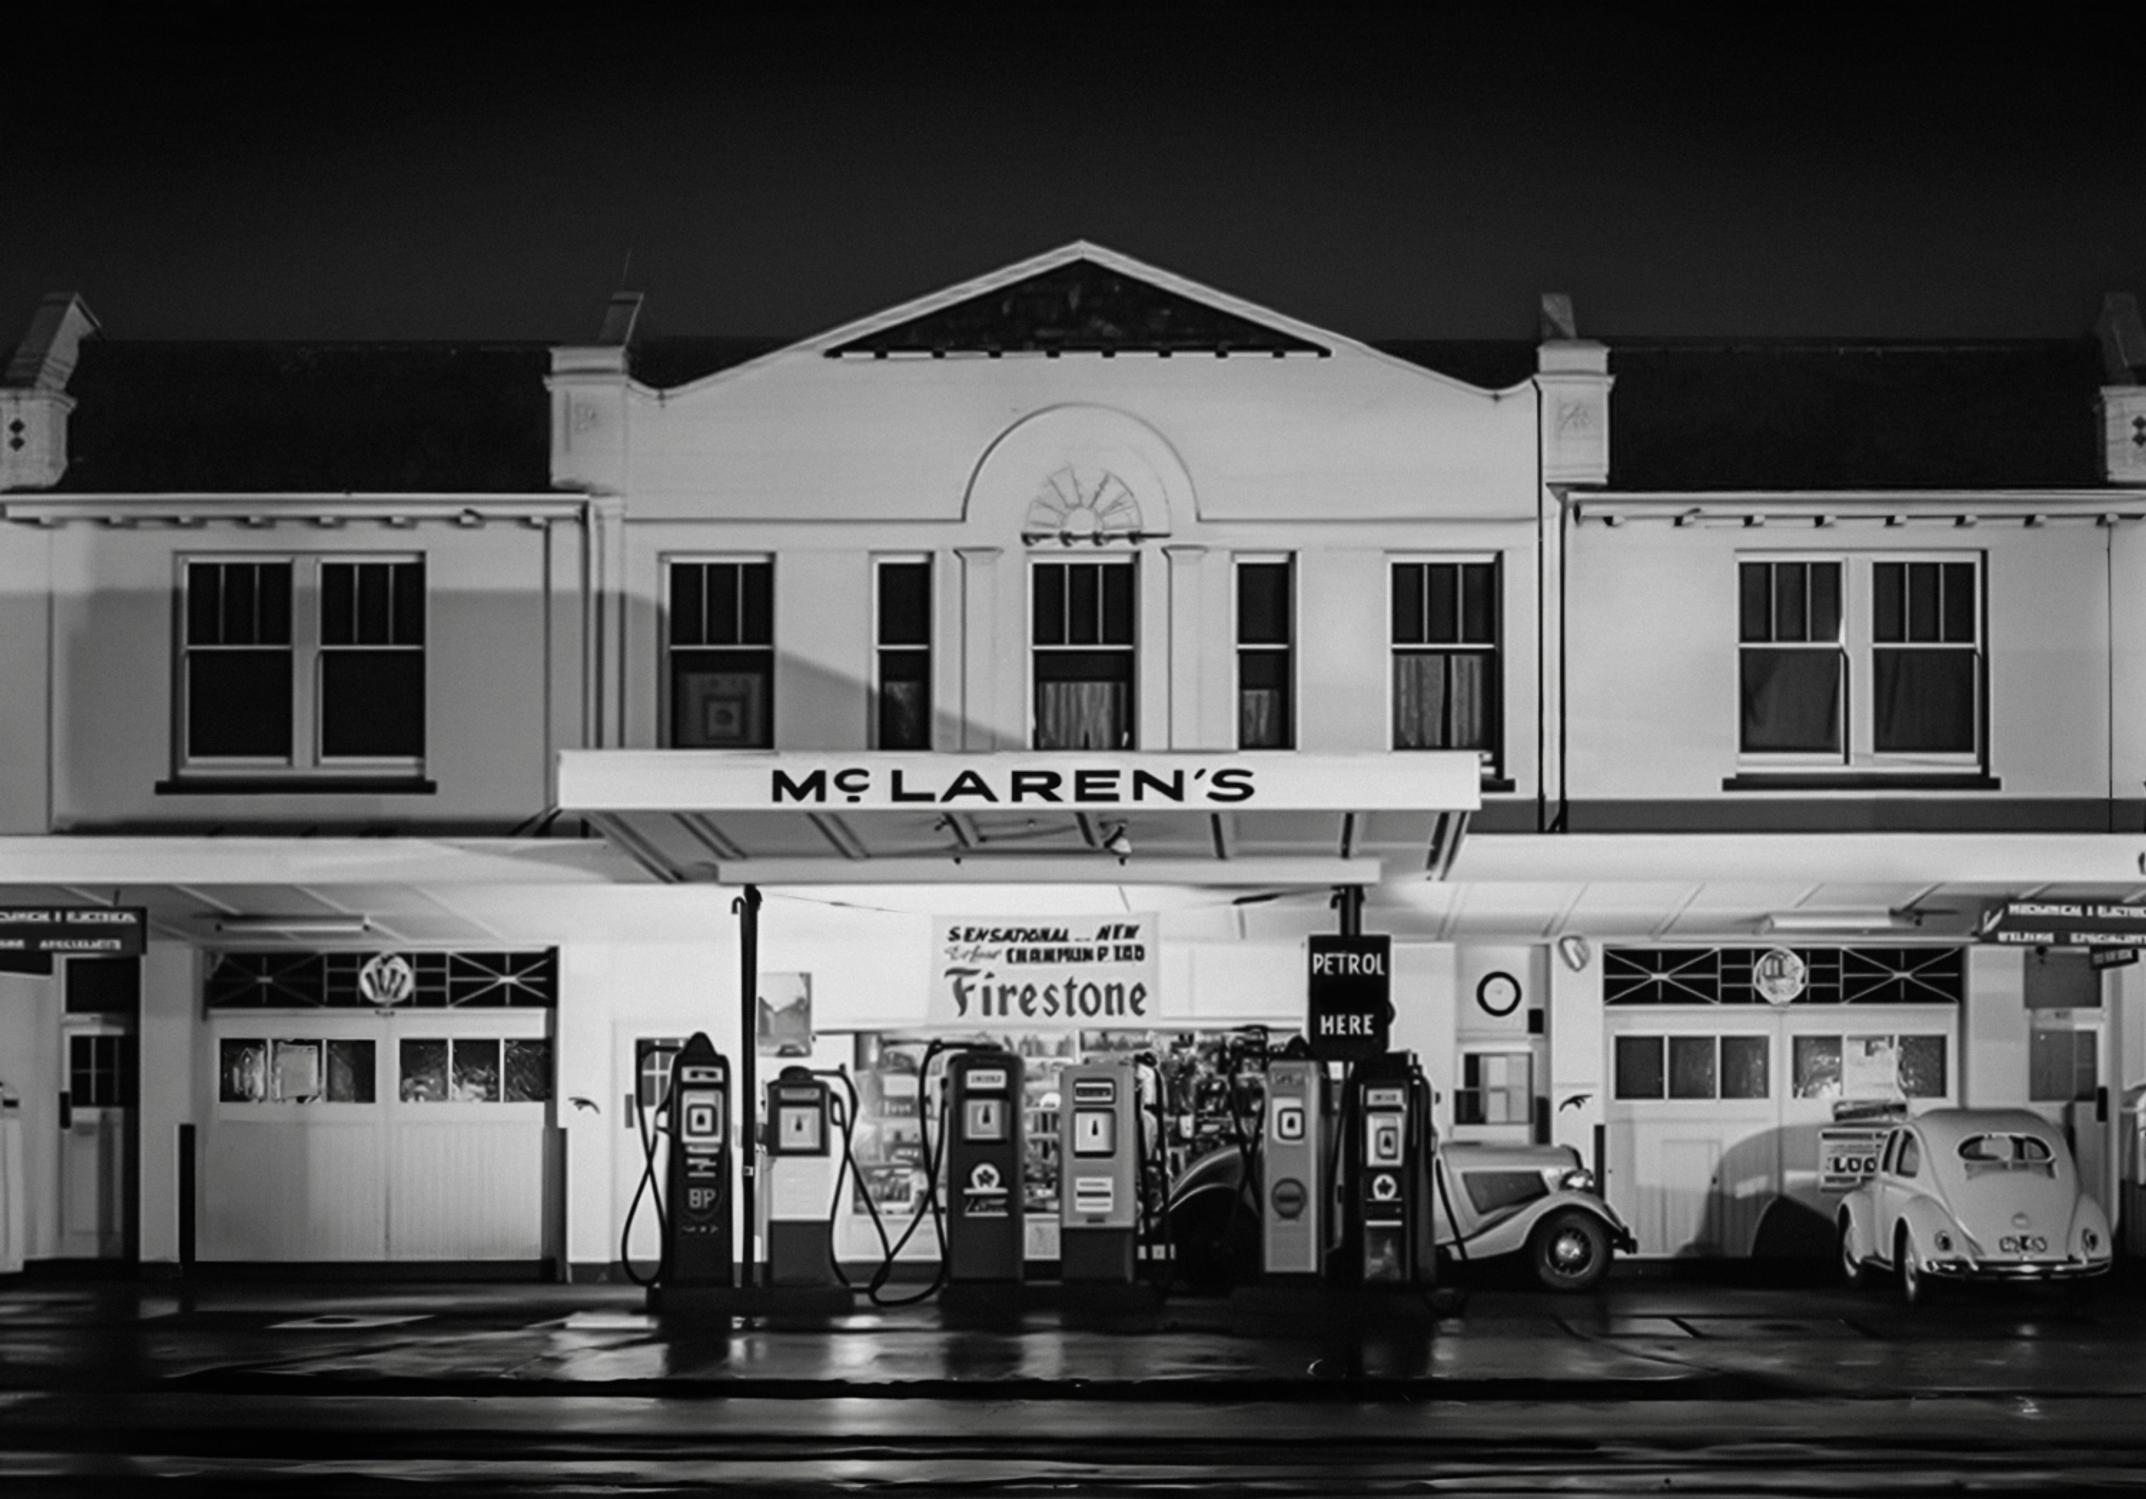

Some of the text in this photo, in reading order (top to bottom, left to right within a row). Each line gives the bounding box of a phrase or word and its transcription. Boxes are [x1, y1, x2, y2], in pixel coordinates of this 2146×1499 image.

[947, 924, 1140, 943] SENSATIONAL NEW
[1312, 952, 1386, 975] PETROL
[944, 966, 1147, 1018] Firestone
[1320, 1013, 1375, 1036] HERE
[688, 1187, 716, 1208] BP
